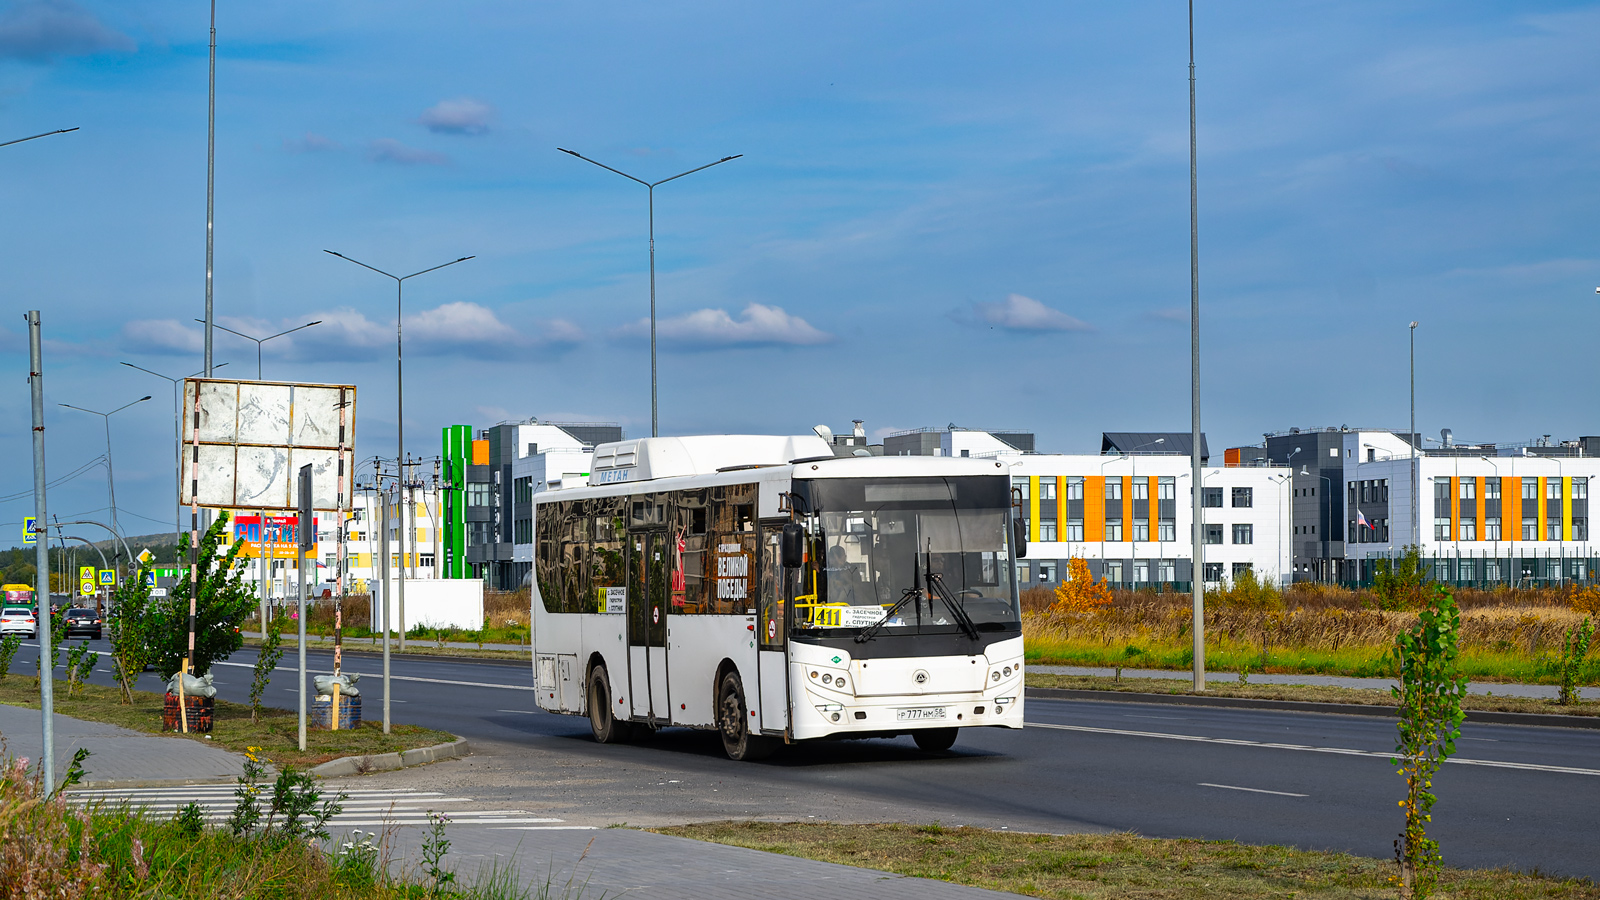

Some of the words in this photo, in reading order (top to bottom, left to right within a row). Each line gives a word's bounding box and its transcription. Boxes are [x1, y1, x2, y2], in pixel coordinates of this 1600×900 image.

[600, 470, 628, 482] МЕТАН
[717, 553, 748, 577] ВЕЛИКОЙ
[717, 578, 748, 601] ПОБЕДЫ!
[816, 609, 840, 626] 411
